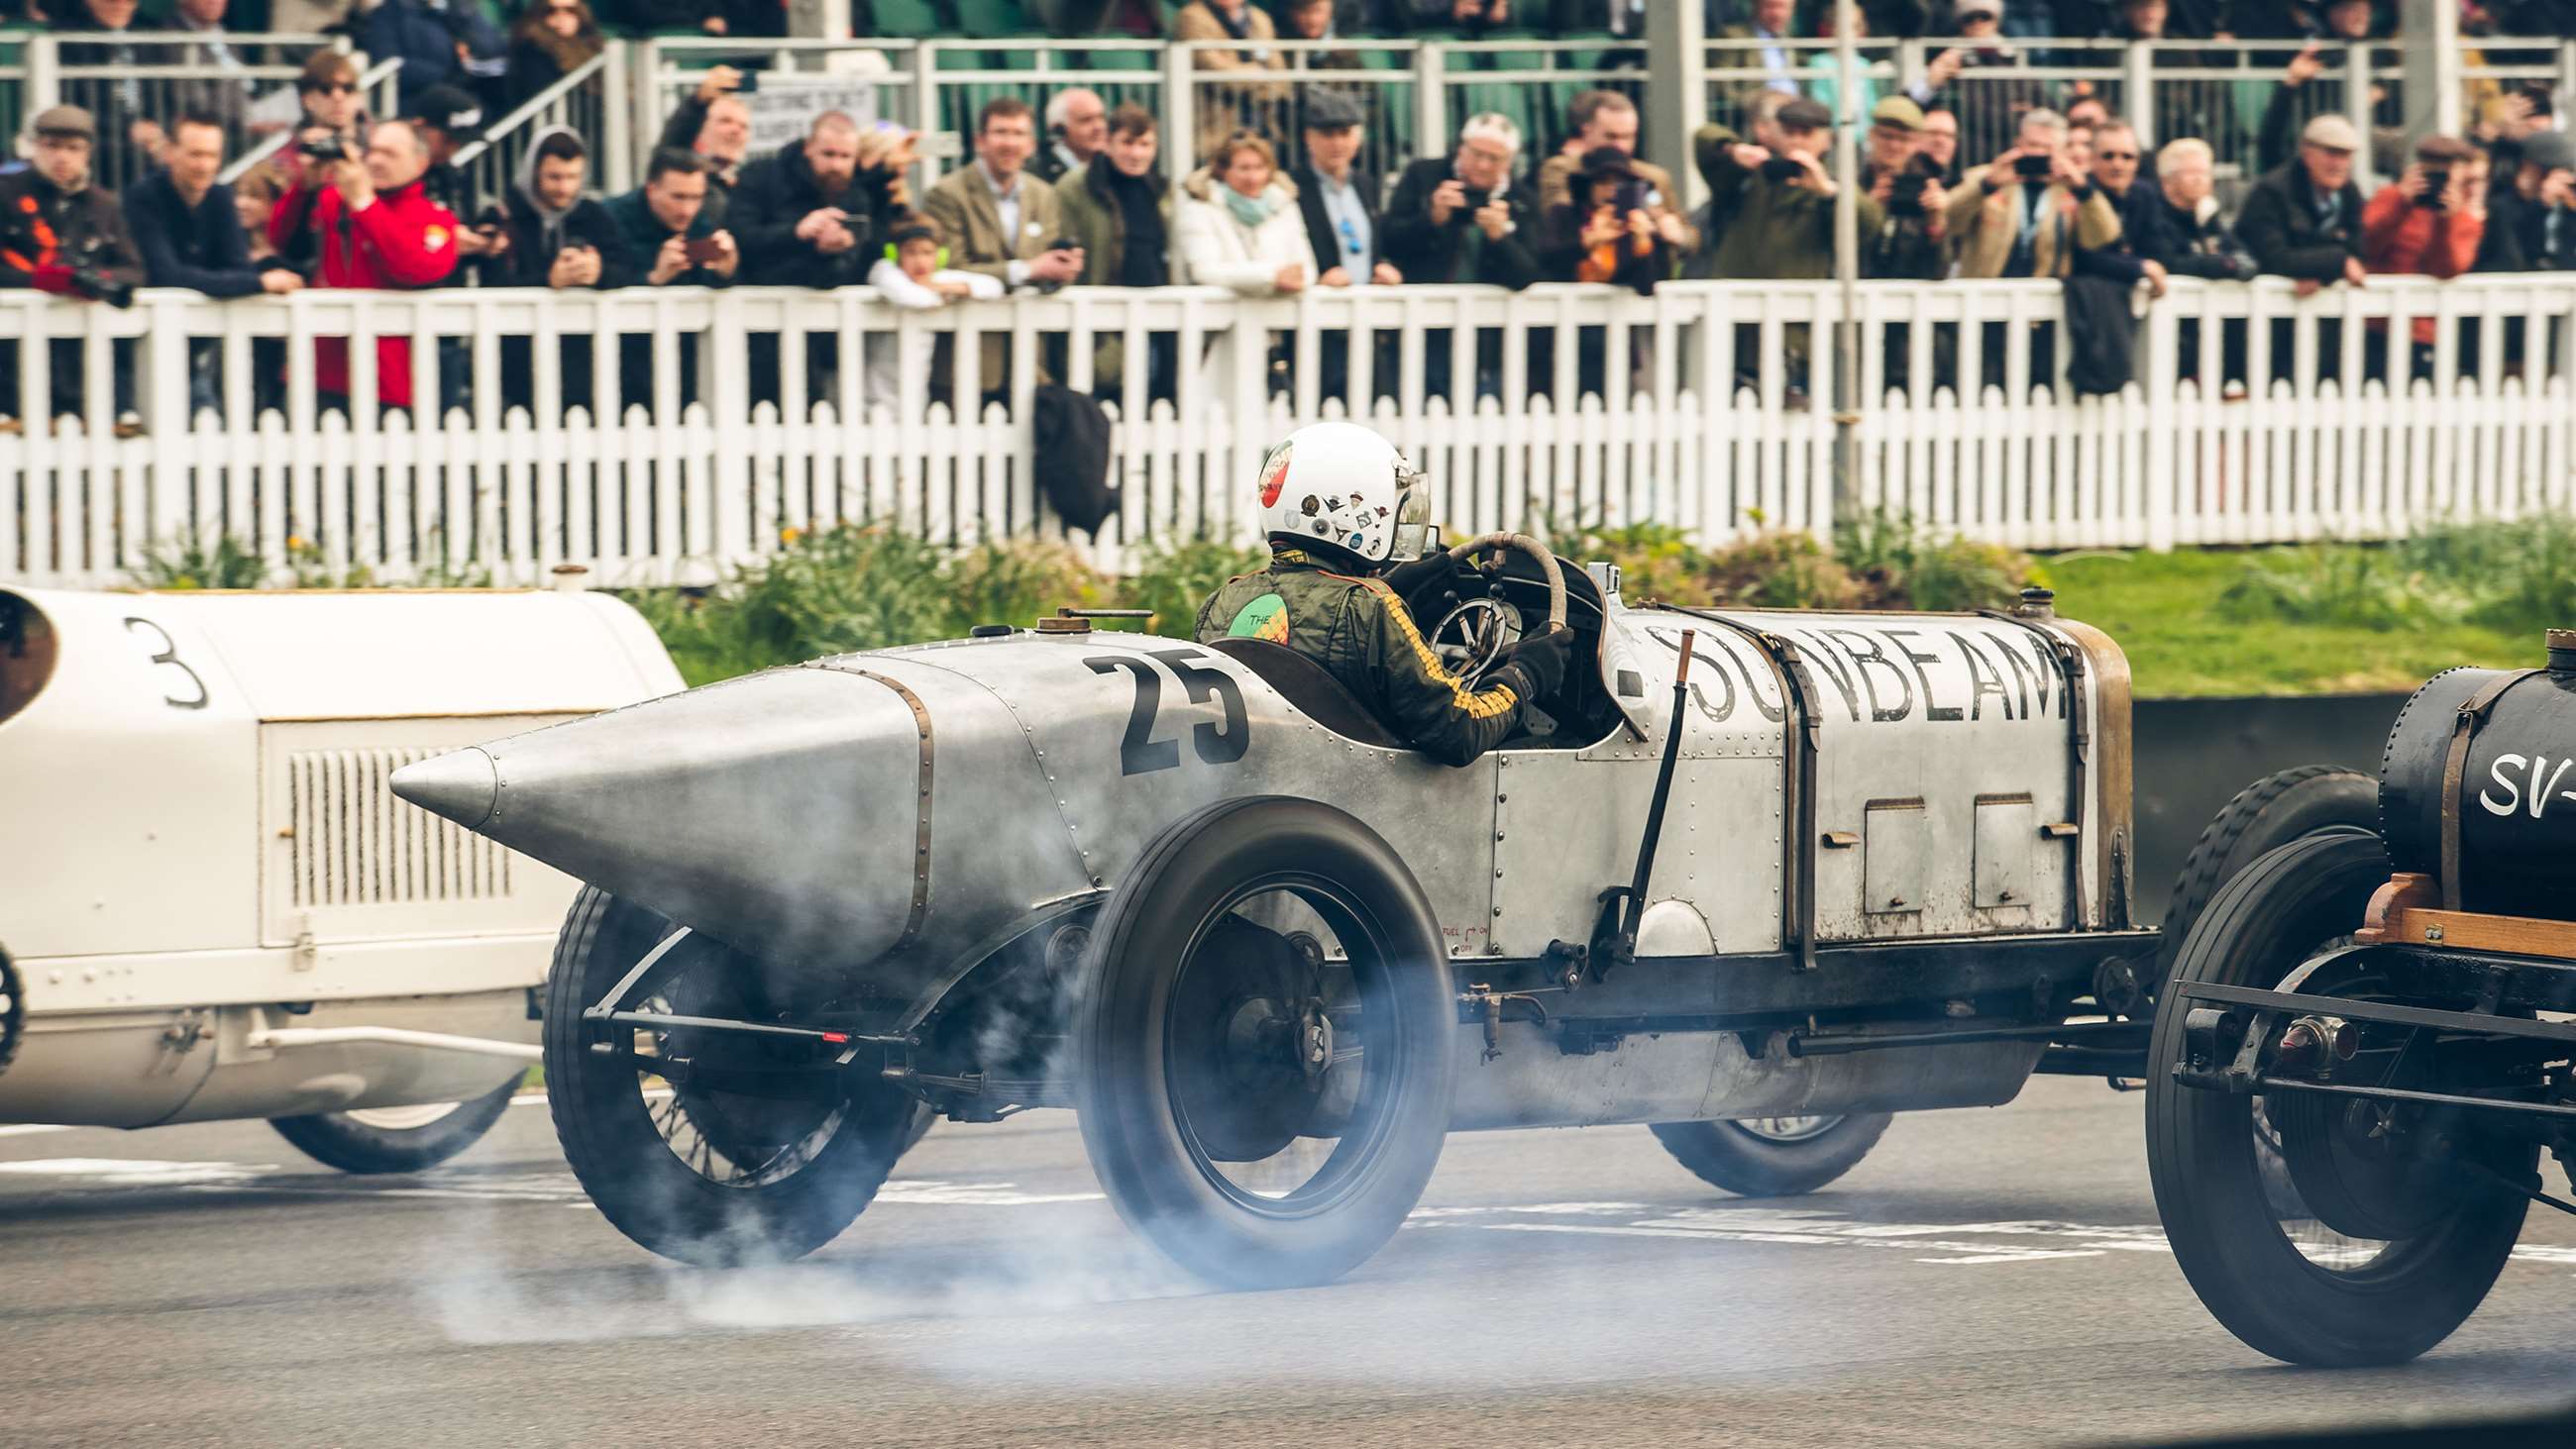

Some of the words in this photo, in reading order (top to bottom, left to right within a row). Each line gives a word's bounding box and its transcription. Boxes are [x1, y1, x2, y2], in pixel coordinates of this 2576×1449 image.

[1249, 614, 1271, 627] THE
[123, 616, 209, 710] 3
[1082, 648, 1250, 776] 25
[1442, 927, 1459, 936] FUEL
[1478, 926, 1488, 935] ON
